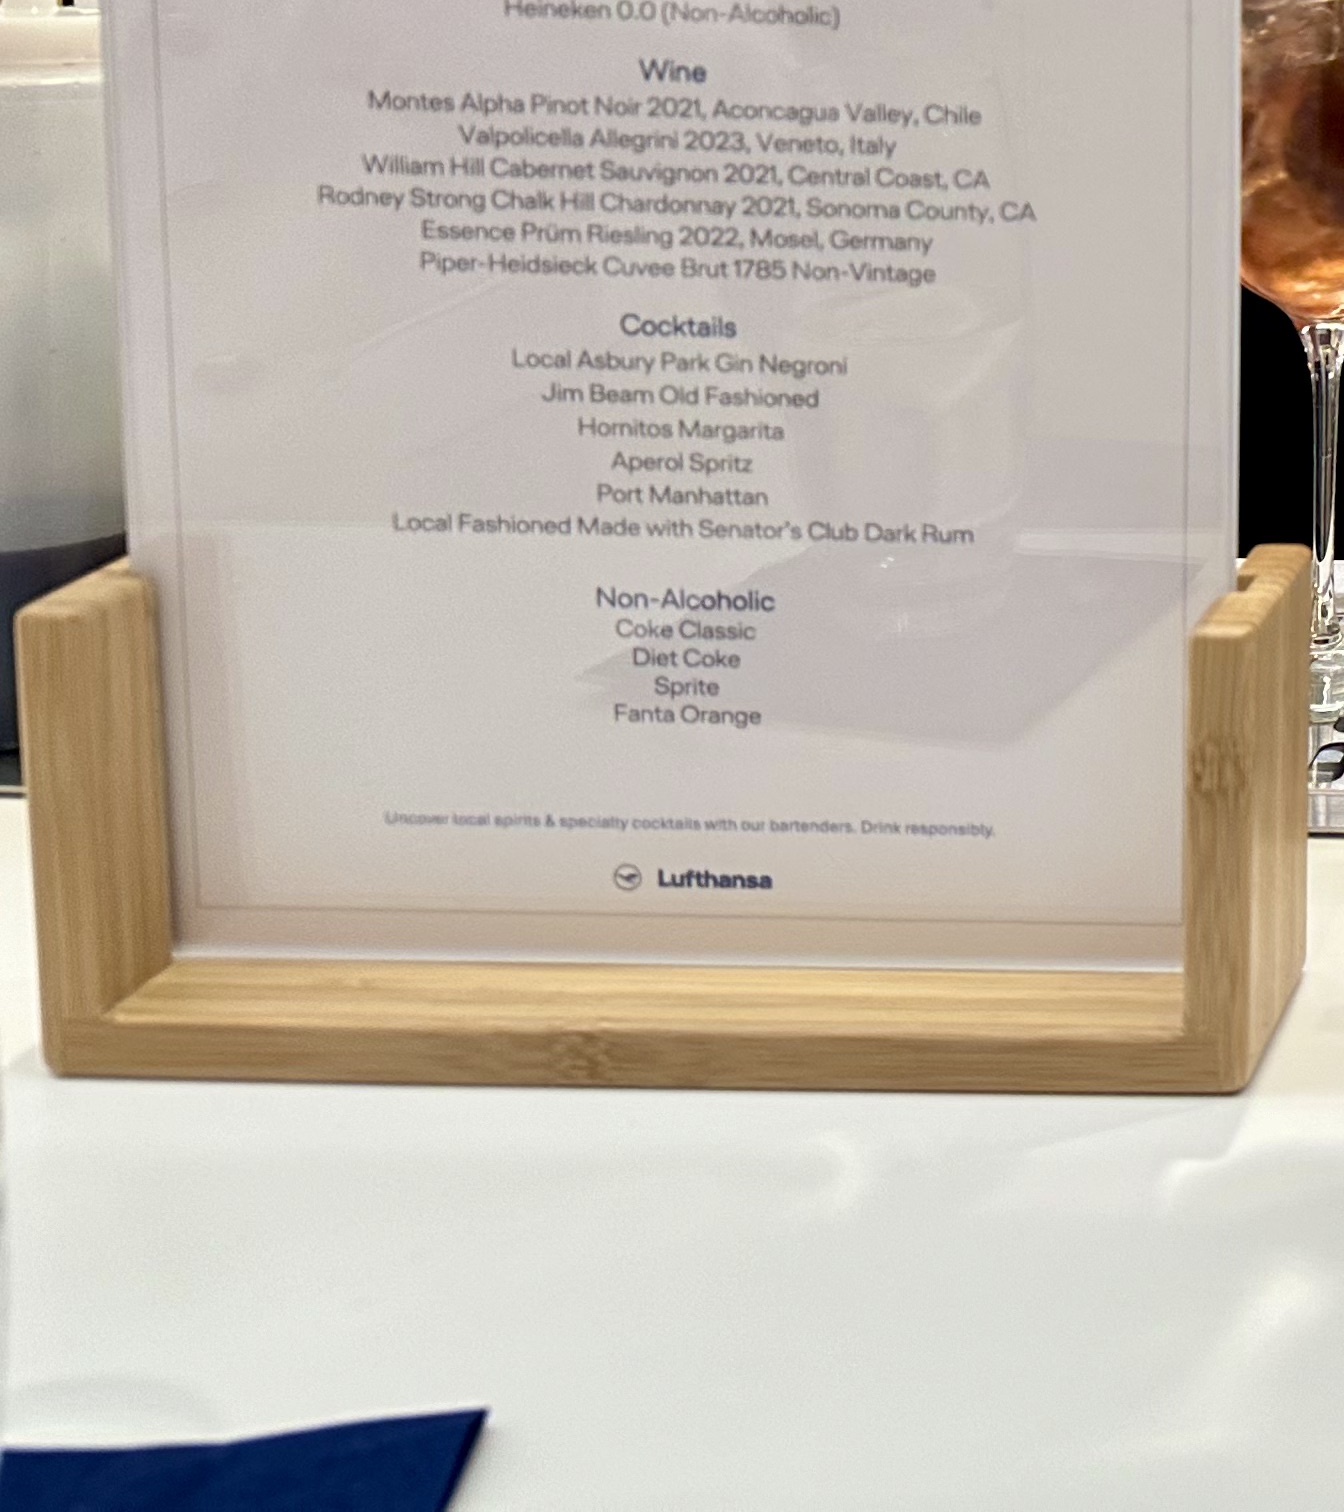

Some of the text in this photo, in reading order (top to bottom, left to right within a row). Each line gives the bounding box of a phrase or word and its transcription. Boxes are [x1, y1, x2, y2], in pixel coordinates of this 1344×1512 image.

[660, 0, 841, 31] (Non-Alcoholic)
[638, 58, 708, 85] Wine
[366, 88, 983, 128] Montes Alpha Pinot Noir 2021, Aconcagua Valley, Chile
[456, 124, 897, 161] Valpolicella Allegrini 2023, Veneto, Italy
[361, 153, 991, 191] William Hill Cabernet Sauvignon 2021, Central Coast, CA
[316, 183, 1037, 225] Rodney Strong Chalk Hill Chardonnay 2021, Sonoma County, CA
[420, 218, 934, 256] Essence Prüm Riesling 2022, Mosel, Germany
[419, 250, 937, 289] Piper-Heidsieck Cuvee Brut 1785 Non-Vintage
[619, 312, 738, 340] Cocktails
[511, 347, 848, 381] Local Asbury Park Gin Negroni
[540, 381, 820, 410] Jim Beam Old Fashioned
[577, 416, 786, 445] Hornitos Margarita
[610, 450, 753, 477] Aperol Spritz
[596, 482, 769, 507] Port Manhattan
[391, 511, 453, 533] Local
[456, 511, 572, 536] Fashioned
[576, 515, 642, 538] Made
[645, 518, 694, 539] with
[806, 520, 860, 543] Club
[863, 522, 917, 544] Dark
[921, 522, 975, 545] Rum
[595, 586, 776, 613] Non-Alcoholic
[614, 617, 757, 642] Coke Classic
[632, 645, 742, 670] Diet Coke
[654, 674, 721, 700] Sprite
[613, 702, 763, 730] Fanta Orange
[558, 816, 629, 832] specialty
[631, 816, 702, 832] cocktails
[703, 818, 738, 833] with
[740, 819, 766, 833] our
[860, 818, 902, 835] Drink
[657, 868, 773, 890] Lufthansa
